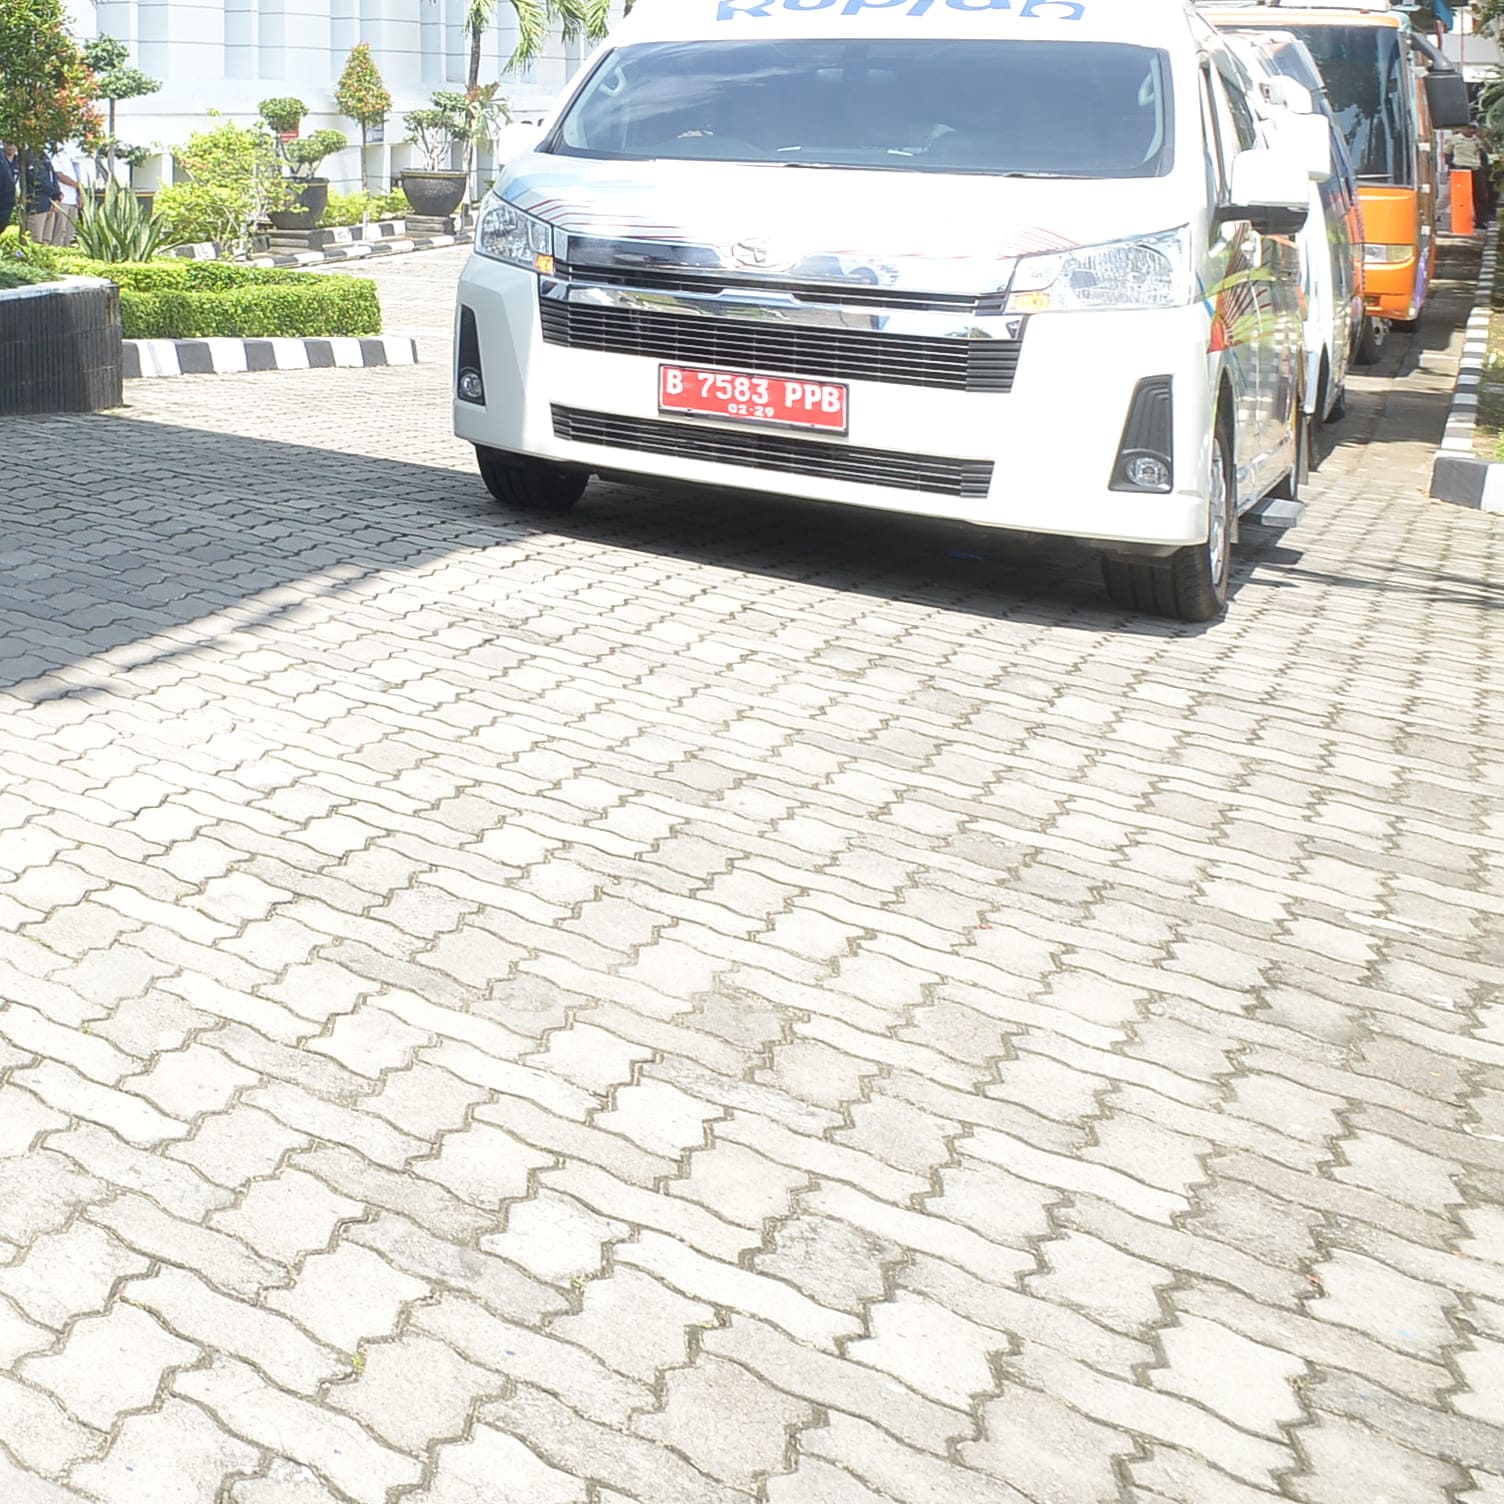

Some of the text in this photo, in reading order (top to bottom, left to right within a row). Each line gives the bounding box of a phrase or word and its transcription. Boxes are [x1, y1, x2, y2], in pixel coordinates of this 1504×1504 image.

[665, 368, 841, 413] B 7583 PPB
